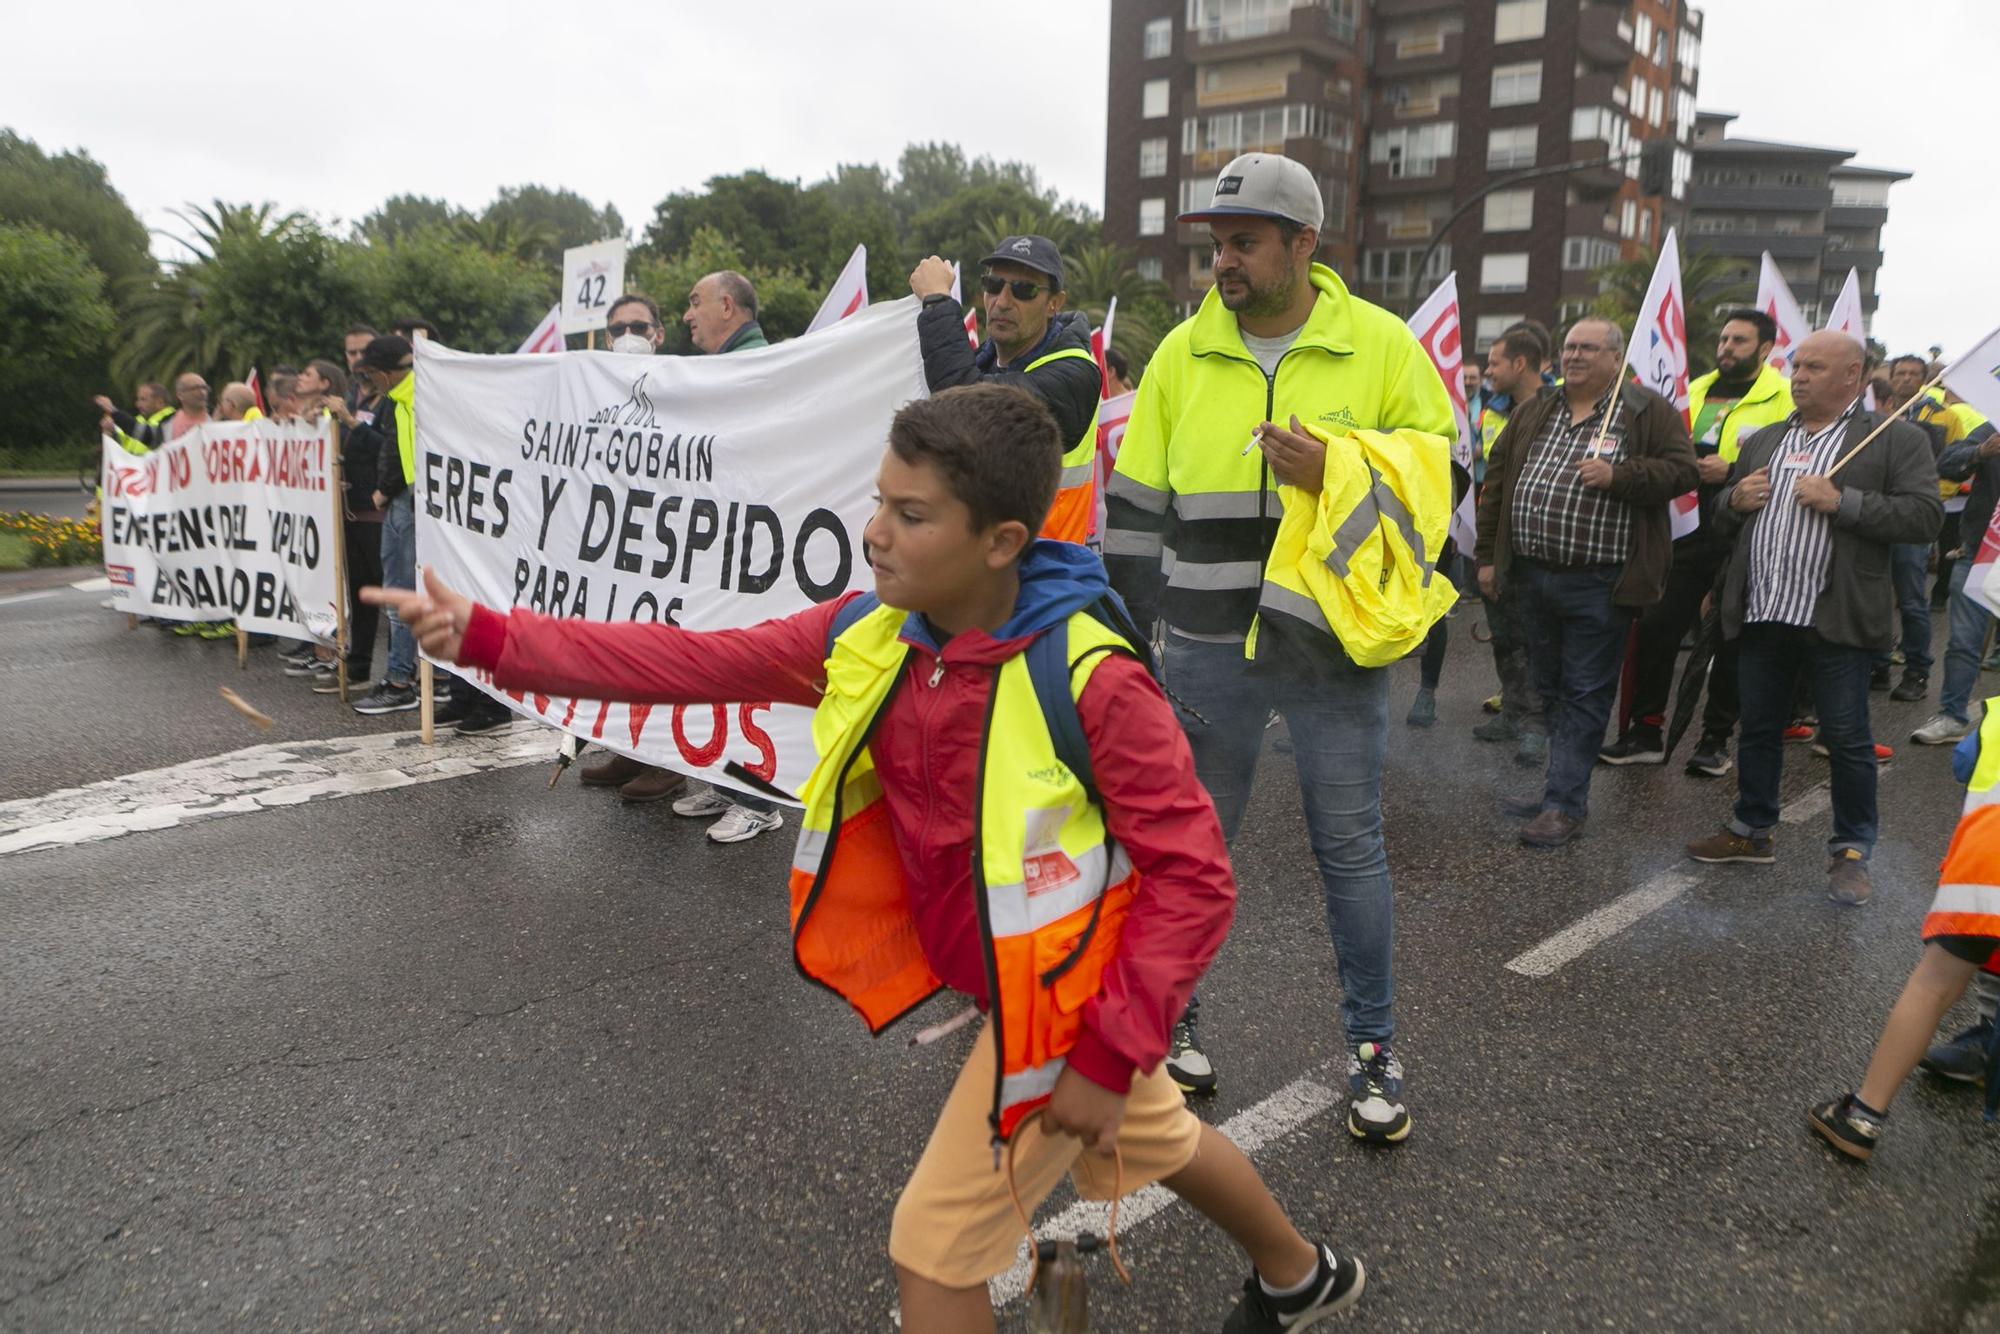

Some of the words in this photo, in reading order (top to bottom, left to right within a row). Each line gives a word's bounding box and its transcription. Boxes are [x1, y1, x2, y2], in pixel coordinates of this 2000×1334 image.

[577, 274, 607, 310] 42
[520, 418, 717, 483] SAINT-GOBAIN
[425, 451, 513, 539] ERES
[538, 475, 568, 552] Y
[577, 484, 874, 604] DESPIDO
